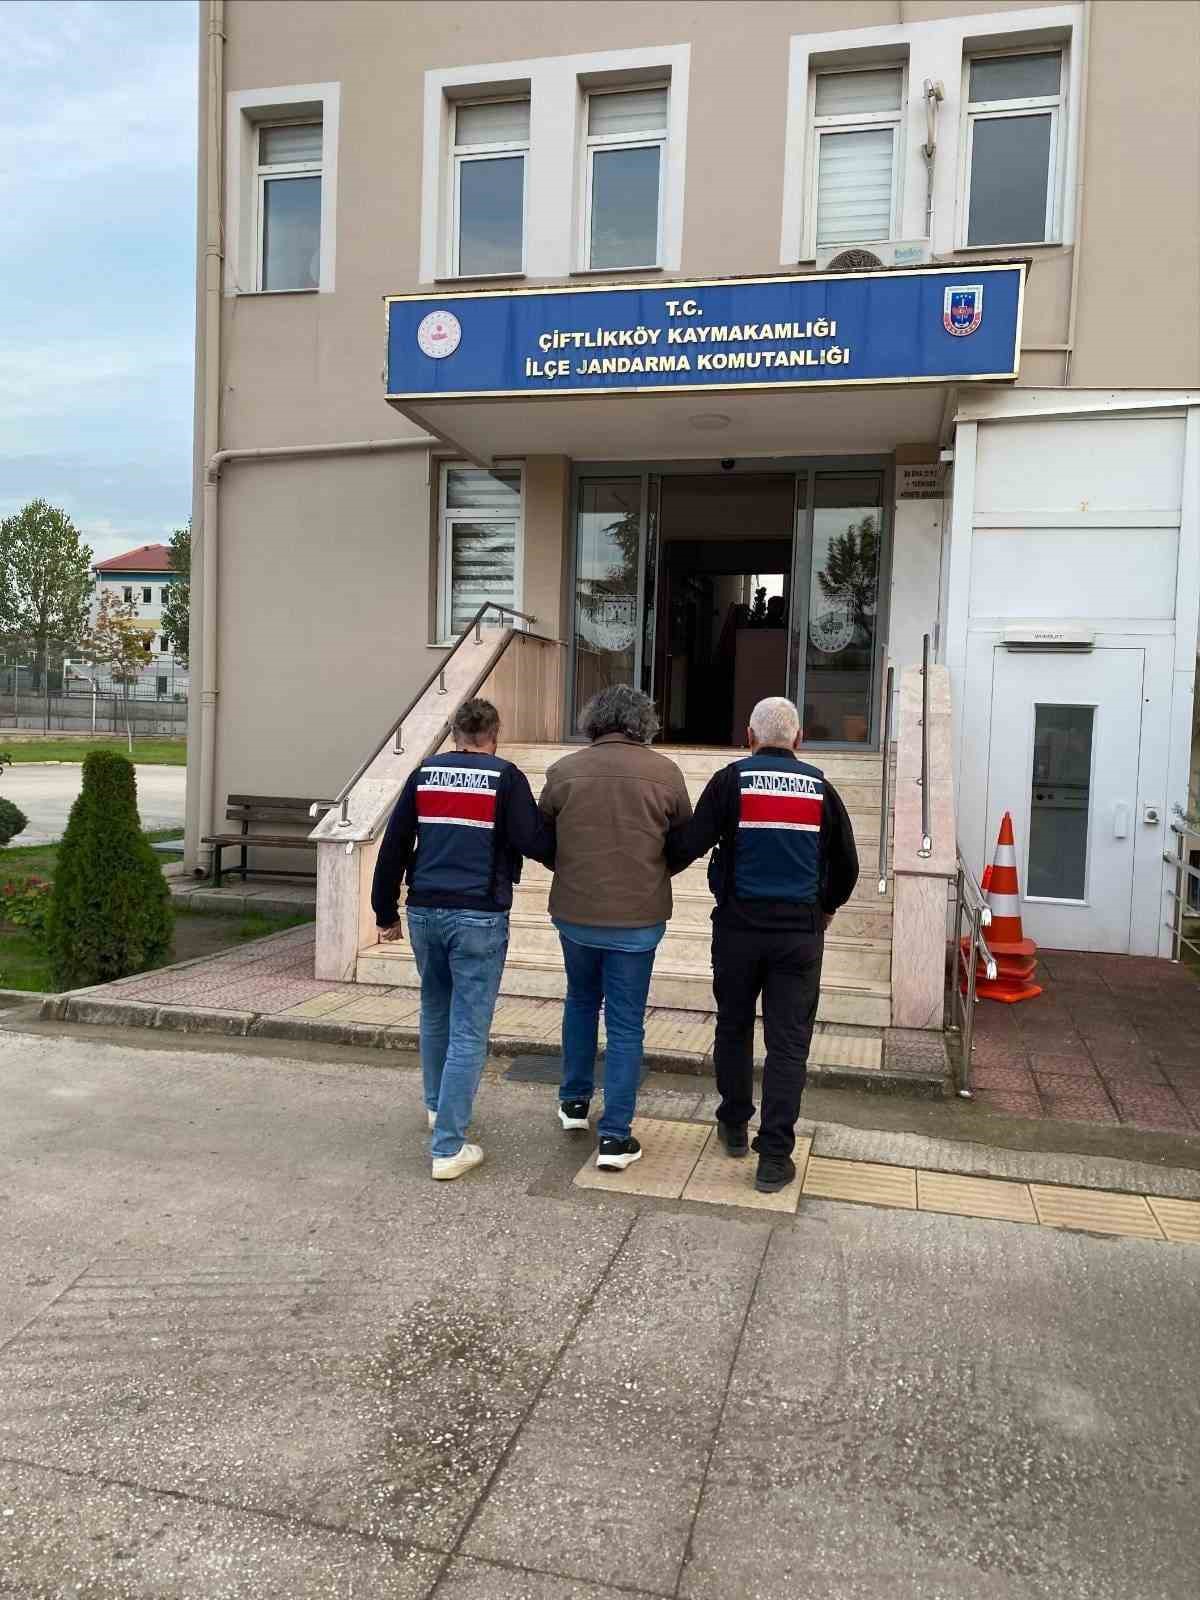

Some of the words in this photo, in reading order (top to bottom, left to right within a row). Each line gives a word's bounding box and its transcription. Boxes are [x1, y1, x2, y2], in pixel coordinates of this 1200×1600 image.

[665, 300, 703, 316] T.C.
[538, 326, 661, 352] ÇİFTLİKKÖY
[667, 318, 837, 344] KAYMAKAMLIĞI
[525, 357, 570, 379] İLÇE
[576, 355, 691, 375] JANDARMA
[697, 346, 850, 370] KOMUTANLIĞI
[425, 770, 489, 789] JANDARMA
[749, 775, 817, 793] JANDARMA
